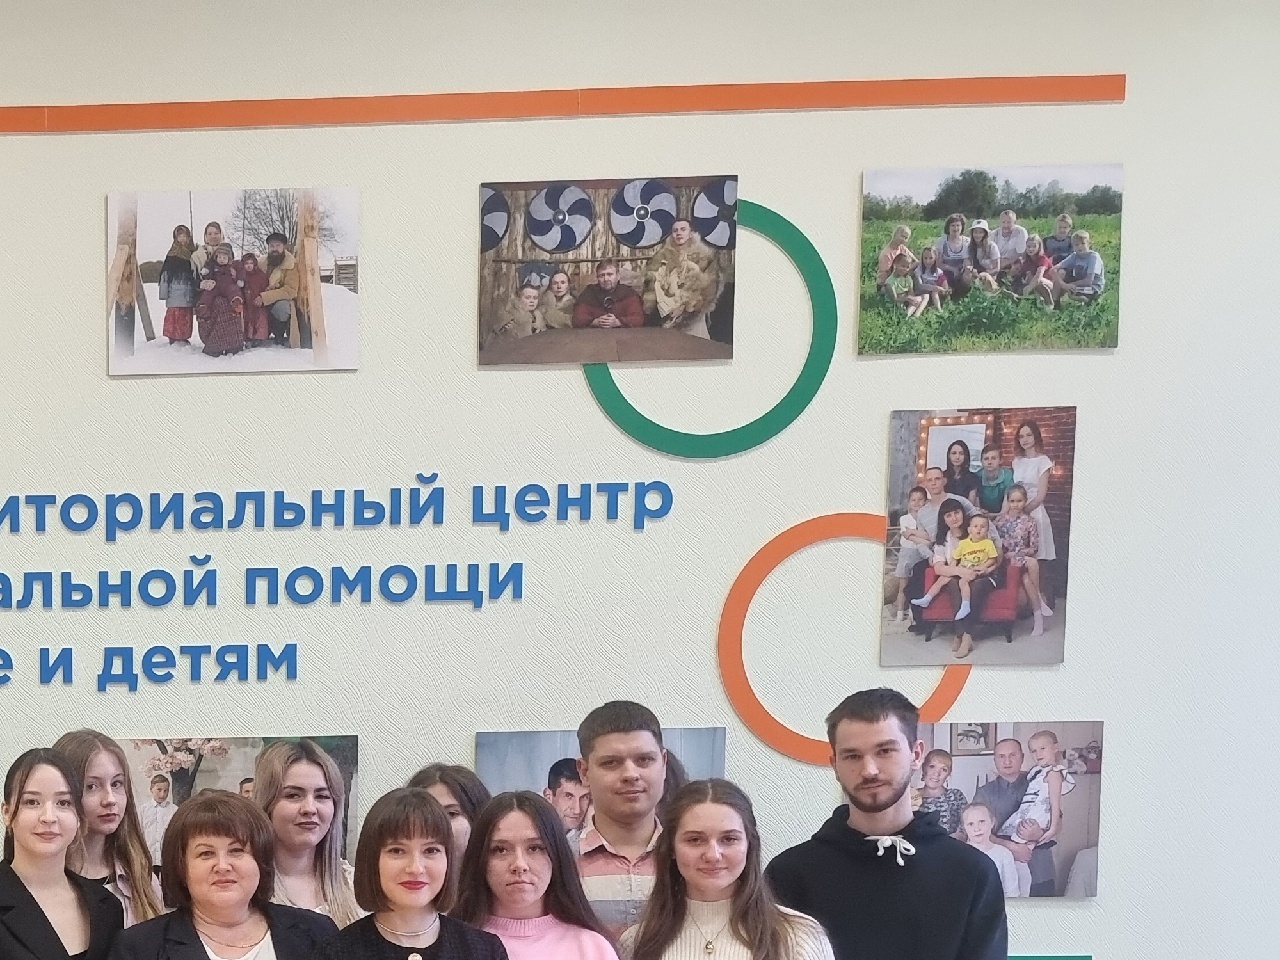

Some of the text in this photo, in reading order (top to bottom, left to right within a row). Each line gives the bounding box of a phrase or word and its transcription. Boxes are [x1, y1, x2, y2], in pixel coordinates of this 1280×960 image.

[472, 480, 675, 530] центр
[245, 563, 524, 608] помощи
[39, 647, 73, 684] и
[97, 643, 299, 691] детям
